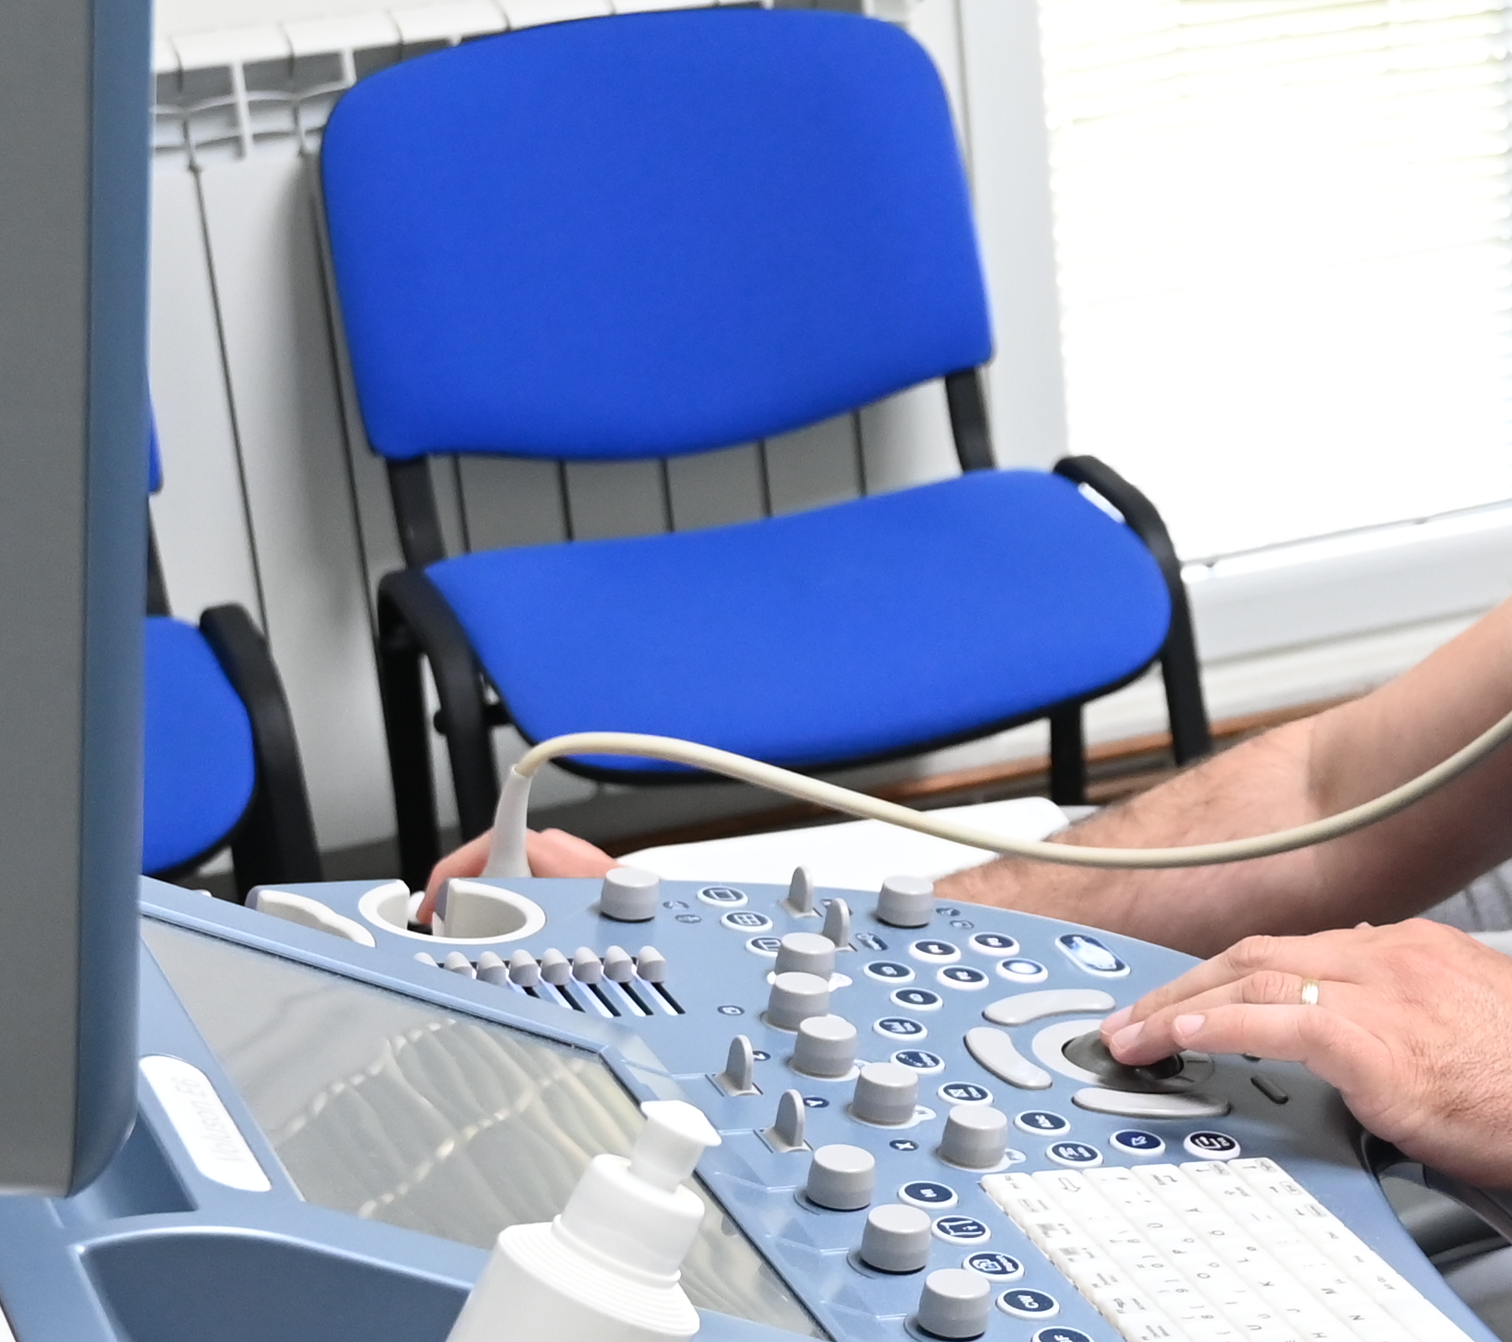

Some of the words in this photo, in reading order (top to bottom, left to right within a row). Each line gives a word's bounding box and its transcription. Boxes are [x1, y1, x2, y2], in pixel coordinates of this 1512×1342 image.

[191, 1100, 247, 1162] Voluson
[895, 1140, 915, 1150] X
[1170, 1247, 1187, 1255] P
[1235, 1256, 1250, 1264] L
[1319, 1286, 1337, 1296] M
[1017, 1294, 1039, 1309] CW
[1285, 1306, 1302, 1314] J
[1348, 1313, 1364, 1322] N
[1245, 1323, 1263, 1332] U
[1310, 1330, 1328, 1339] H
